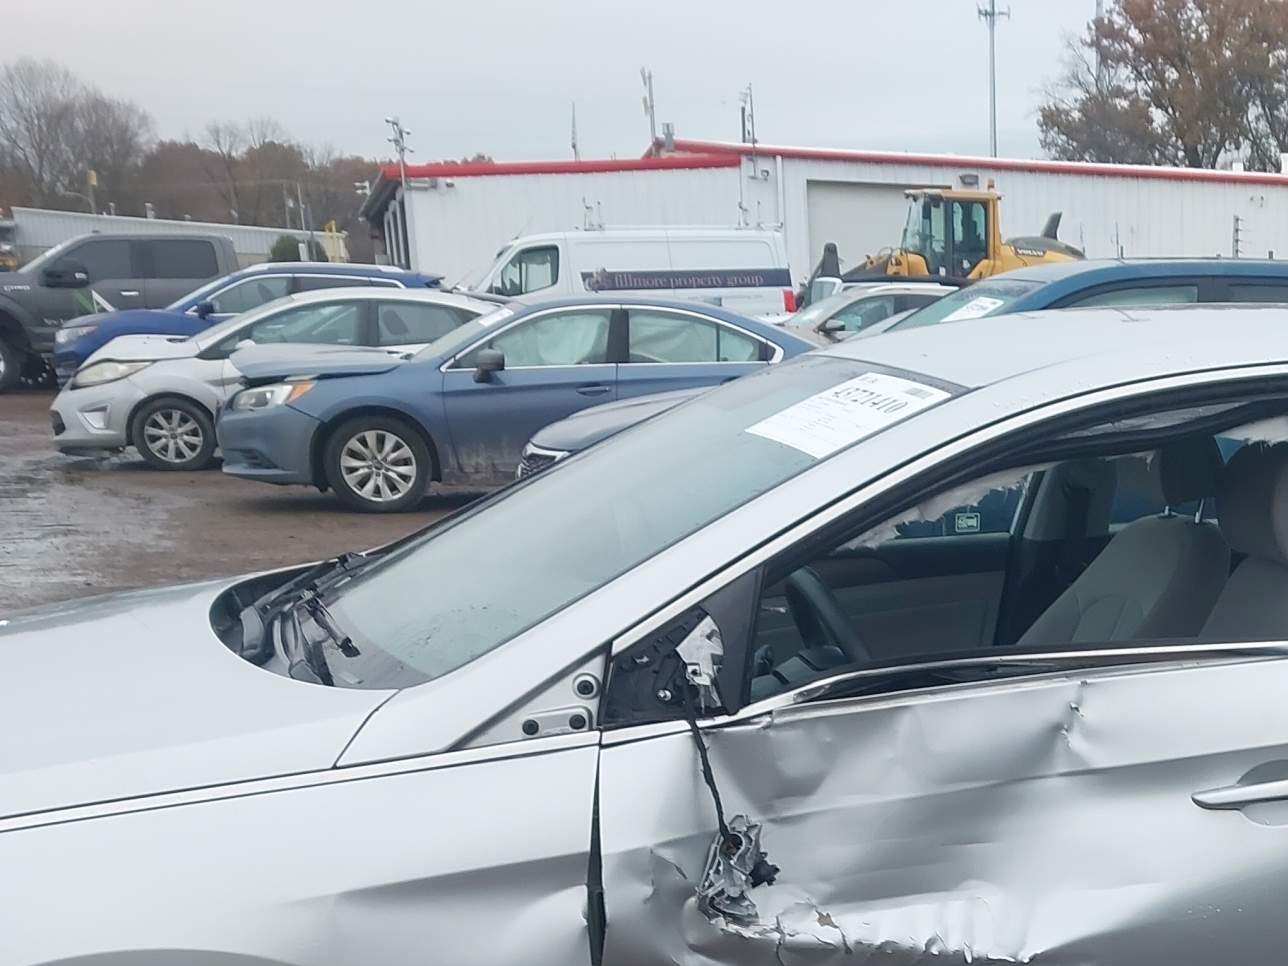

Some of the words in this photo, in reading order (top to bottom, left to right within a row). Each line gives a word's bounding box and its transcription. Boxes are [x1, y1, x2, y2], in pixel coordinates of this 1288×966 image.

[614, 273, 667, 288] fillmore
[670, 276, 723, 288] property
[727, 274, 764, 287] group
